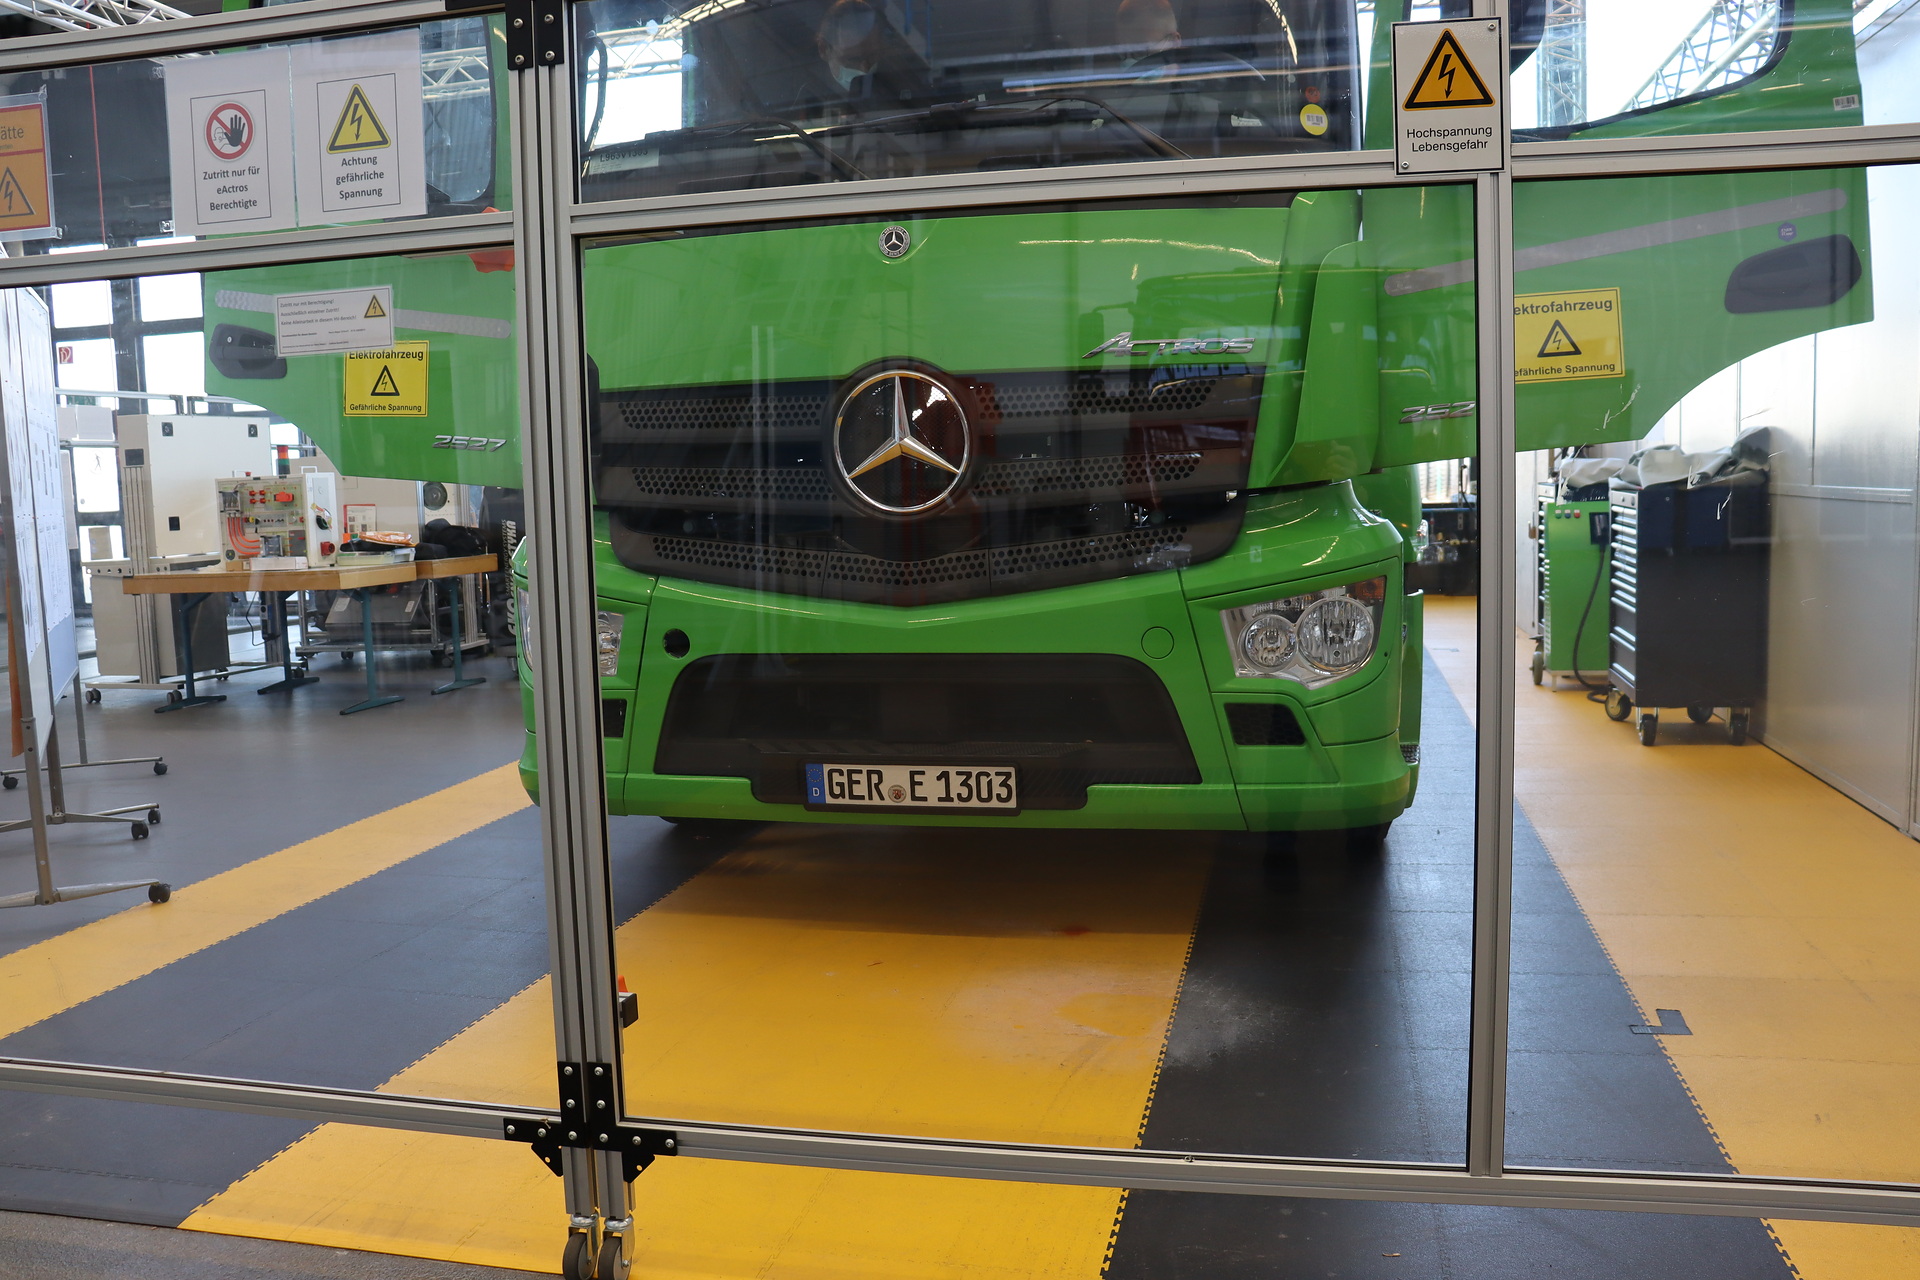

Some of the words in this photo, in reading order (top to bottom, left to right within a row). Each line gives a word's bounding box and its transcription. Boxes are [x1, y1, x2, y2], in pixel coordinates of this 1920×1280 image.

[1406, 126, 1493, 139] Hochspannung
[1411, 139, 1488, 153] Lebensgefahr
[341, 156, 378, 167] Achtung
[203, 170, 230, 181] Zutritt
[231, 168, 246, 177] nur
[248, 166, 260, 176] für
[335, 170, 385, 186] gefährliche
[216, 184, 249, 195] eActros
[339, 187, 383, 200] Spannung
[209, 198, 258, 211] Berechtigte
[349, 349, 424, 361] Elektrofahrzeug
[1564, 363, 1615, 375] Spannung
[349, 403, 387, 411] Gefährliche
[388, 403, 422, 413] Spannung
[432, 434, 508, 453] 2527
[812, 787, 820, 797] D
[827, 768, 885, 801] GER
[909, 770, 928, 802] E
[936, 770, 1013, 803] 1303
